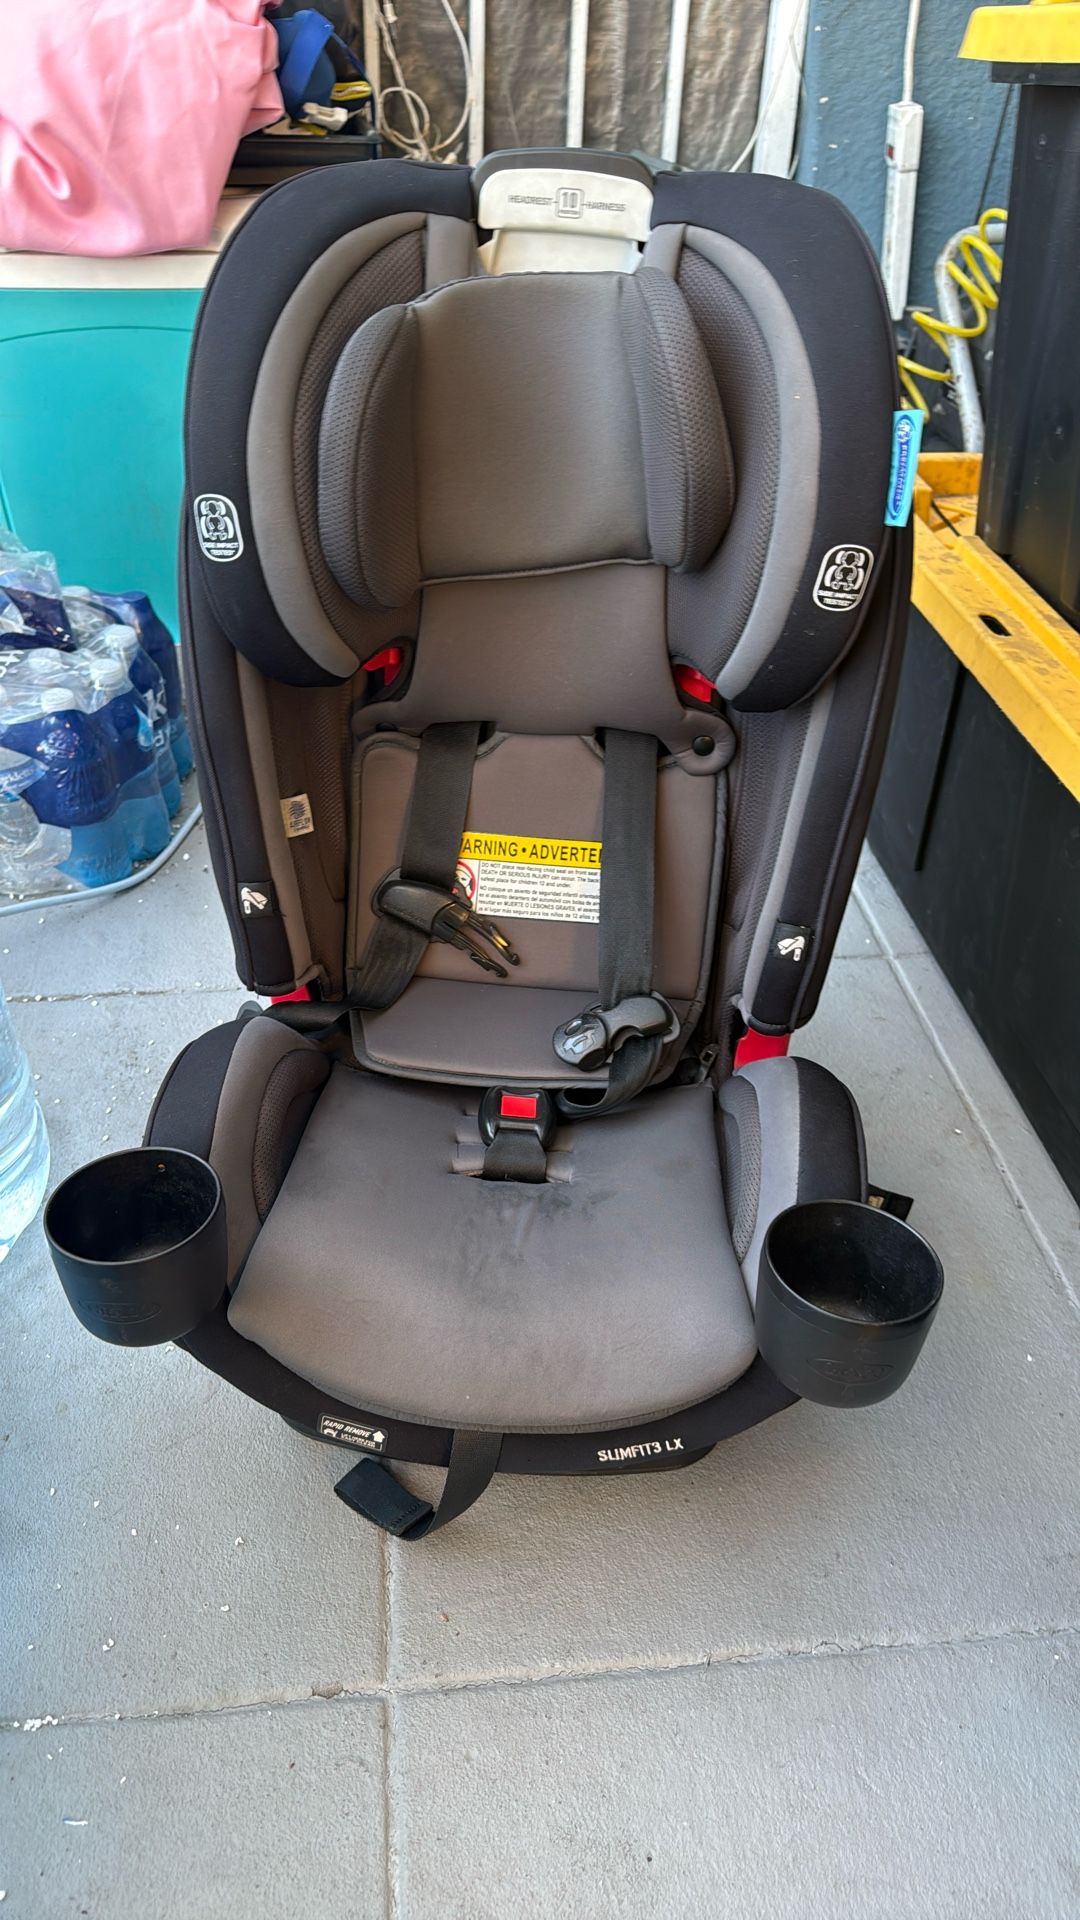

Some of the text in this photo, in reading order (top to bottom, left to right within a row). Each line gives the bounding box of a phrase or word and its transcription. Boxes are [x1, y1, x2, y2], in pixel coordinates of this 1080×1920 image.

[507, 194, 553, 206] HEADREST
[561, 191, 578, 209] 10
[586, 200, 627, 212] HARNESS
[324, 1420, 372, 1438] RAPID REMOVE
[597, 1438, 684, 1462] SLIMFIT3 LX
